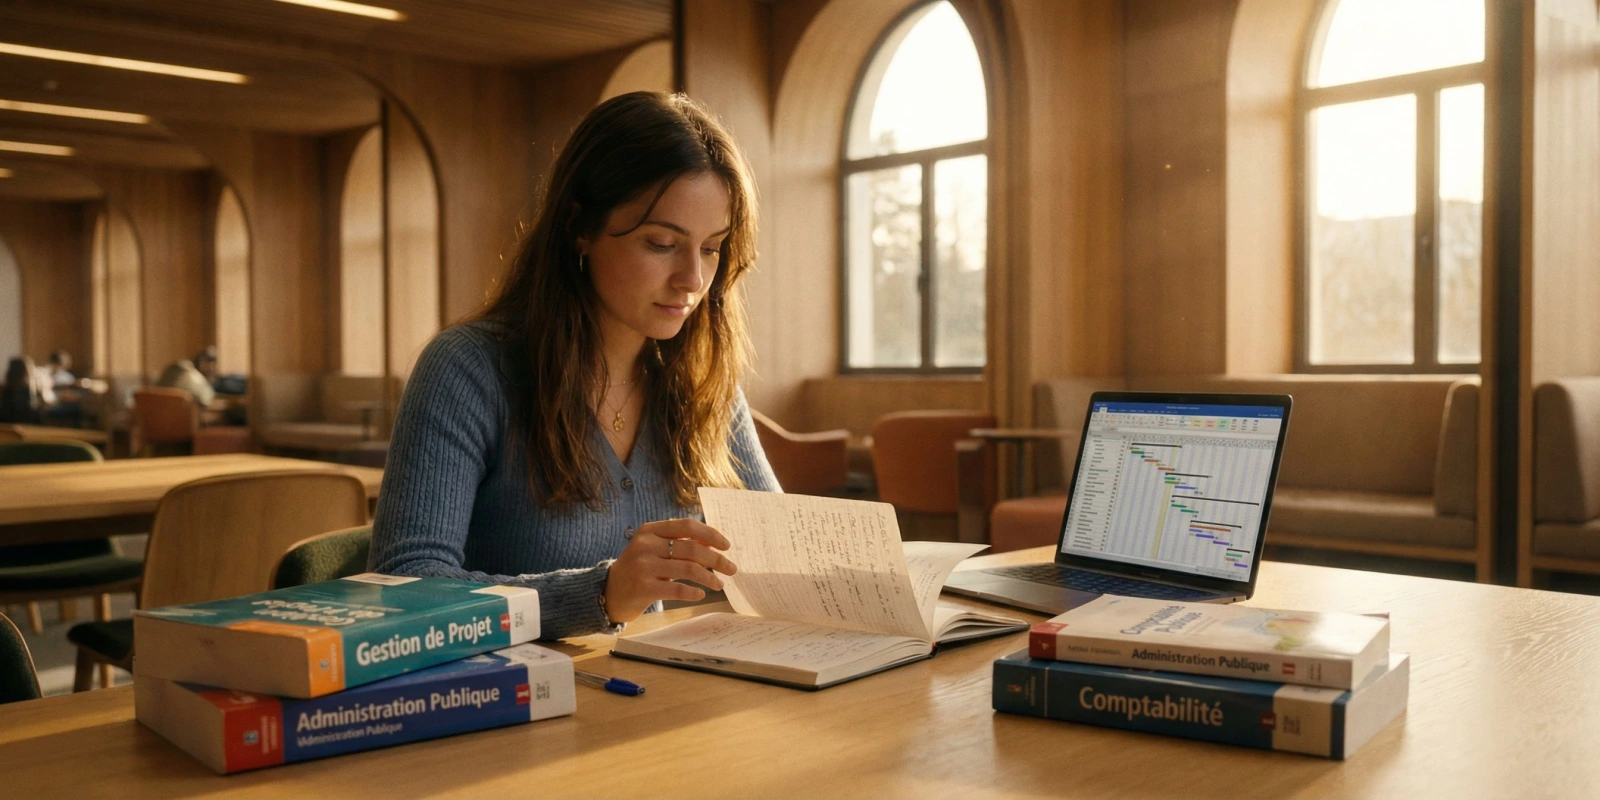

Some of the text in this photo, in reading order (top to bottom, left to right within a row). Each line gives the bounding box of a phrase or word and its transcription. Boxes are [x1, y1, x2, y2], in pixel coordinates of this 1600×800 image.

[356, 634, 420, 666] Gestion
[425, 625, 444, 650] de
[448, 616, 492, 645] Projet
[1132, 648, 1216, 667] Administration
[1219, 656, 1270, 673] Publique
[296, 687, 500, 732] Administration Publique
[1079, 686, 1224, 726] Comptabilité
